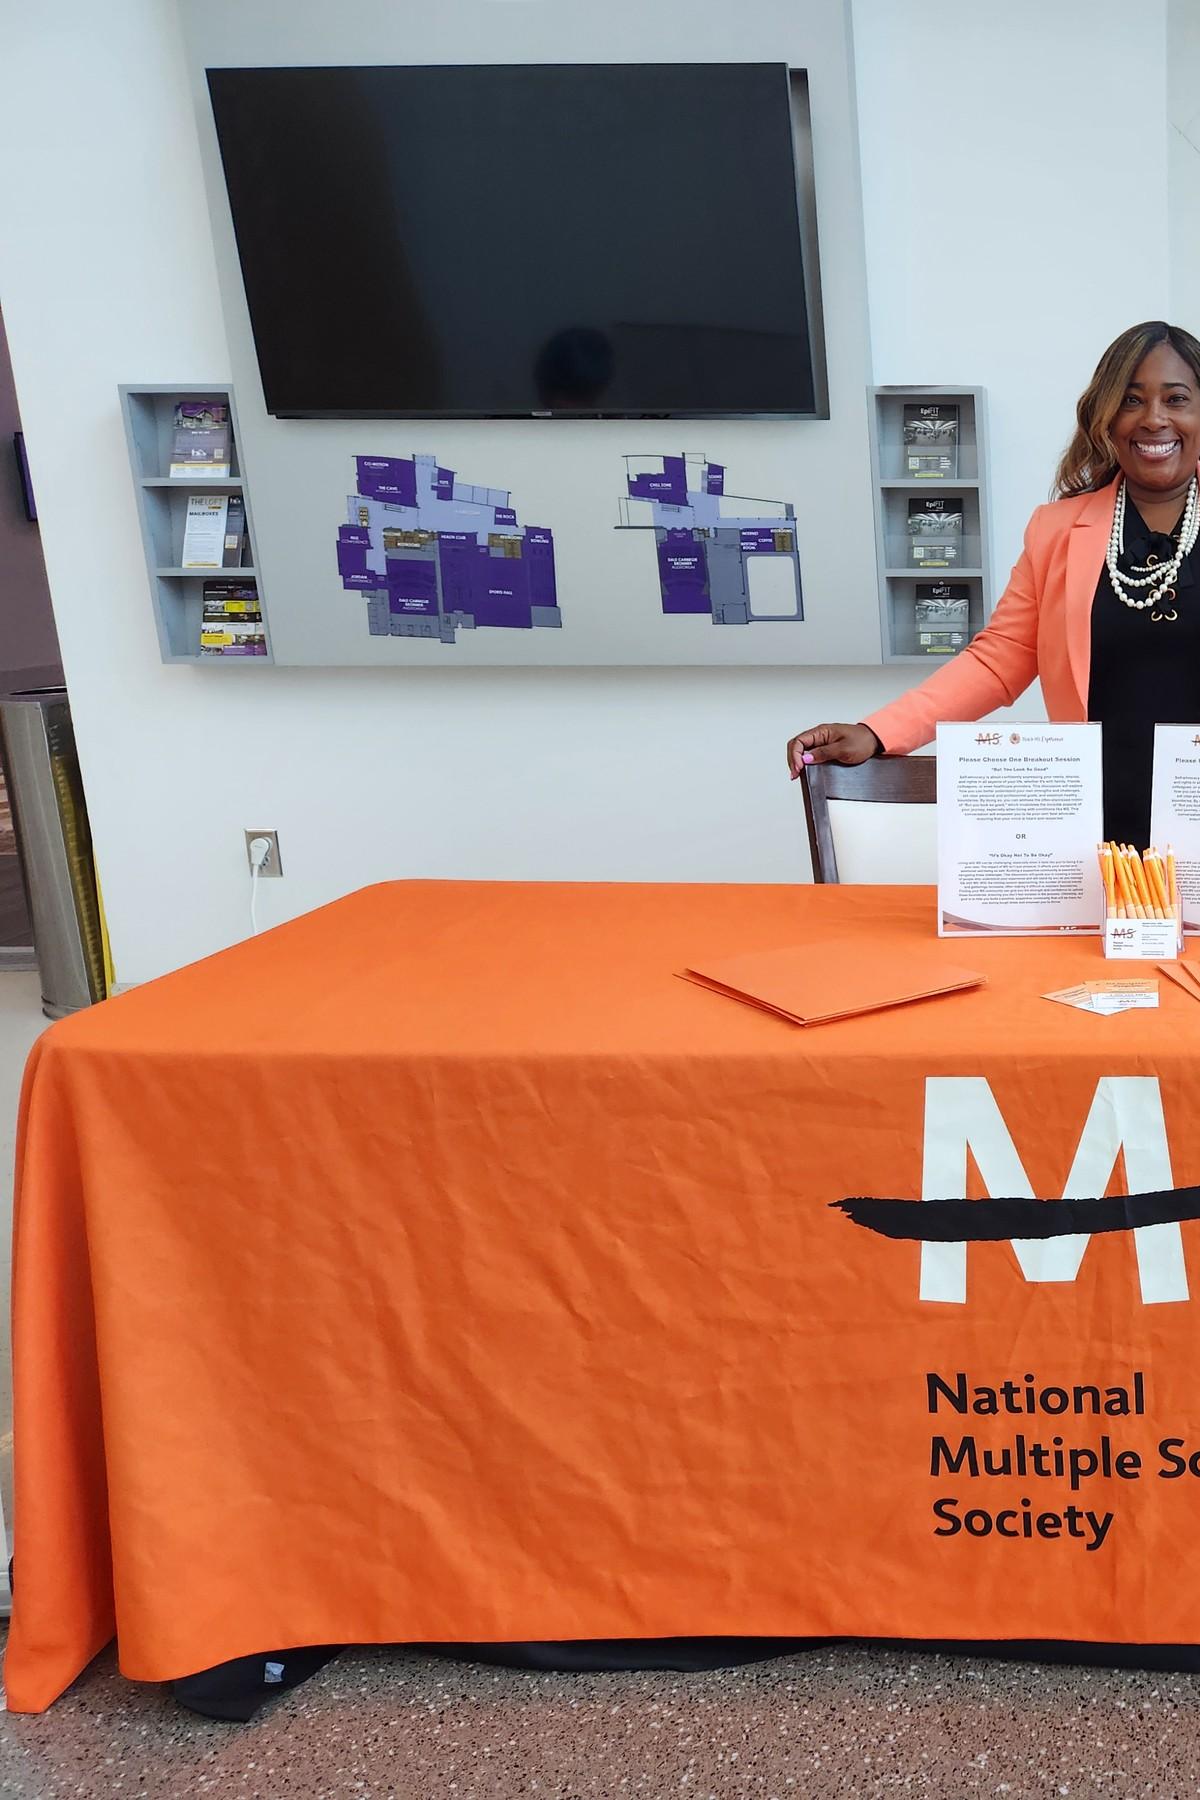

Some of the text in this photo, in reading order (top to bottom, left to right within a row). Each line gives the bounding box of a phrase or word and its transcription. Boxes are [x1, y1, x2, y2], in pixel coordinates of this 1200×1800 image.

[925, 1371, 1146, 1416] National
[929, 1434, 1142, 1490] Multiple
[932, 1497, 1115, 1551] Society
